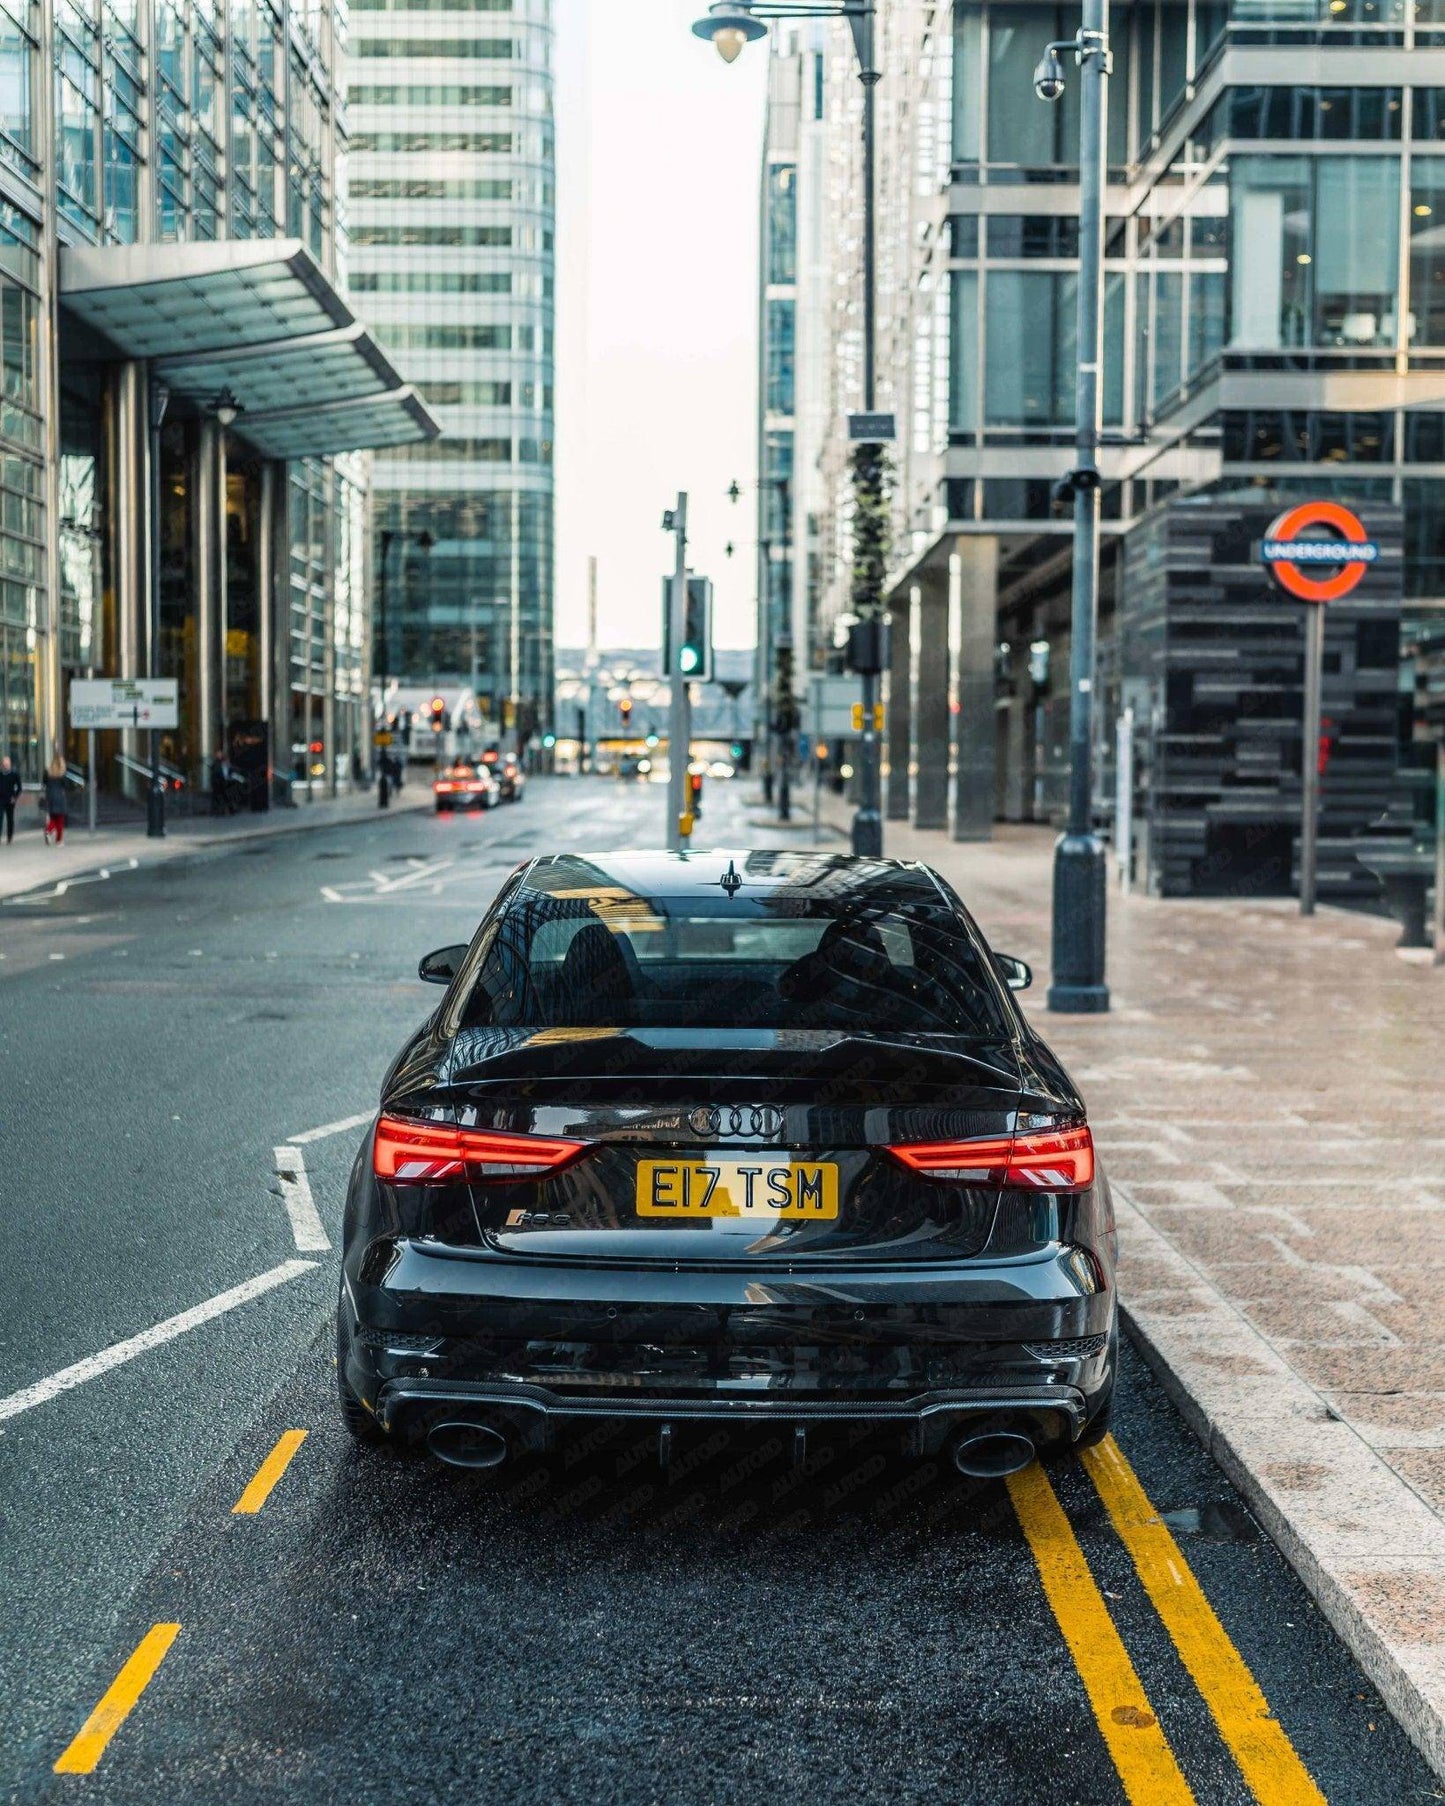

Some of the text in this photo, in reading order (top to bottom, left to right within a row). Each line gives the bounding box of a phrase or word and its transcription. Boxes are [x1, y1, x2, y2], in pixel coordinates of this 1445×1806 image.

[1264, 543, 1377, 560] UNDERGROUND
[652, 1166, 824, 1209] E17 TSM
